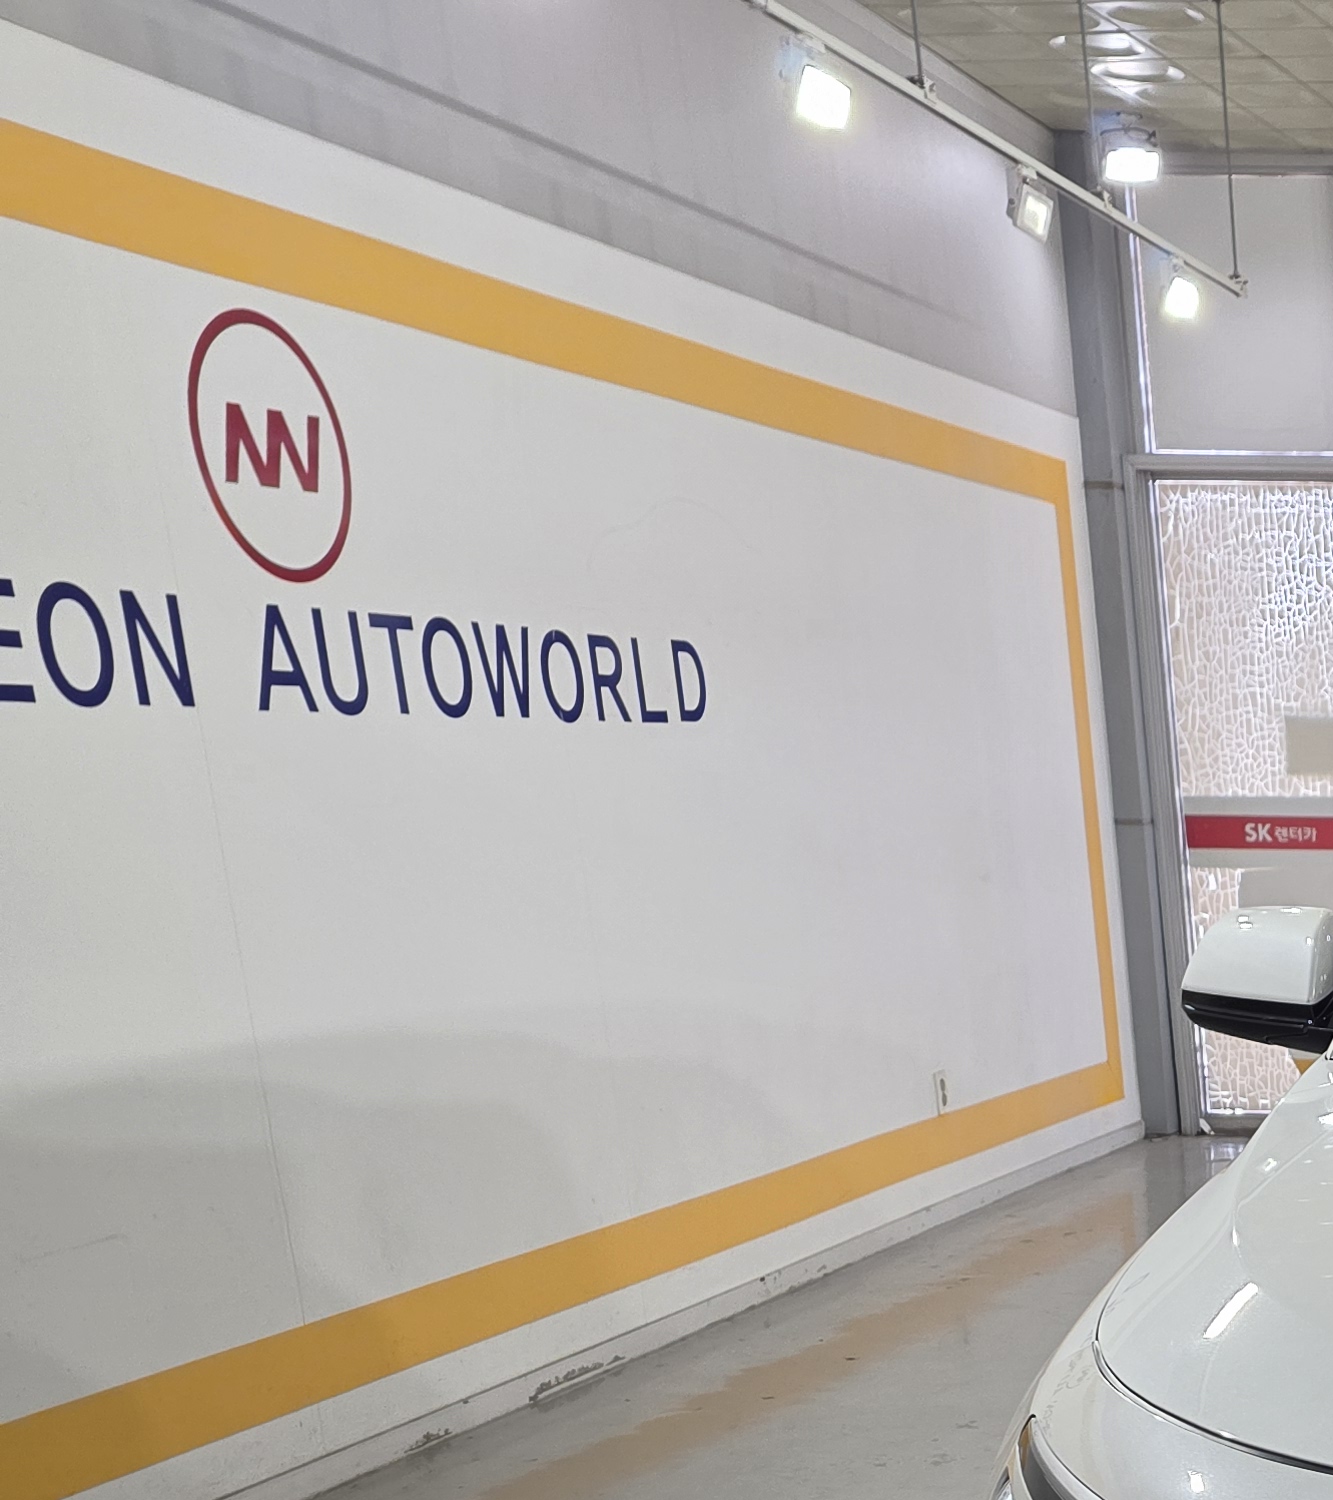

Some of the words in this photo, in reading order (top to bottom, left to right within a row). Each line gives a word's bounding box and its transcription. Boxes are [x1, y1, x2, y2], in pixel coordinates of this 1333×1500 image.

[258, 604, 707, 723] AUTOWORLD
[1244, 823, 1273, 843] SK
[1274, 826, 1317, 843] 렌터카
